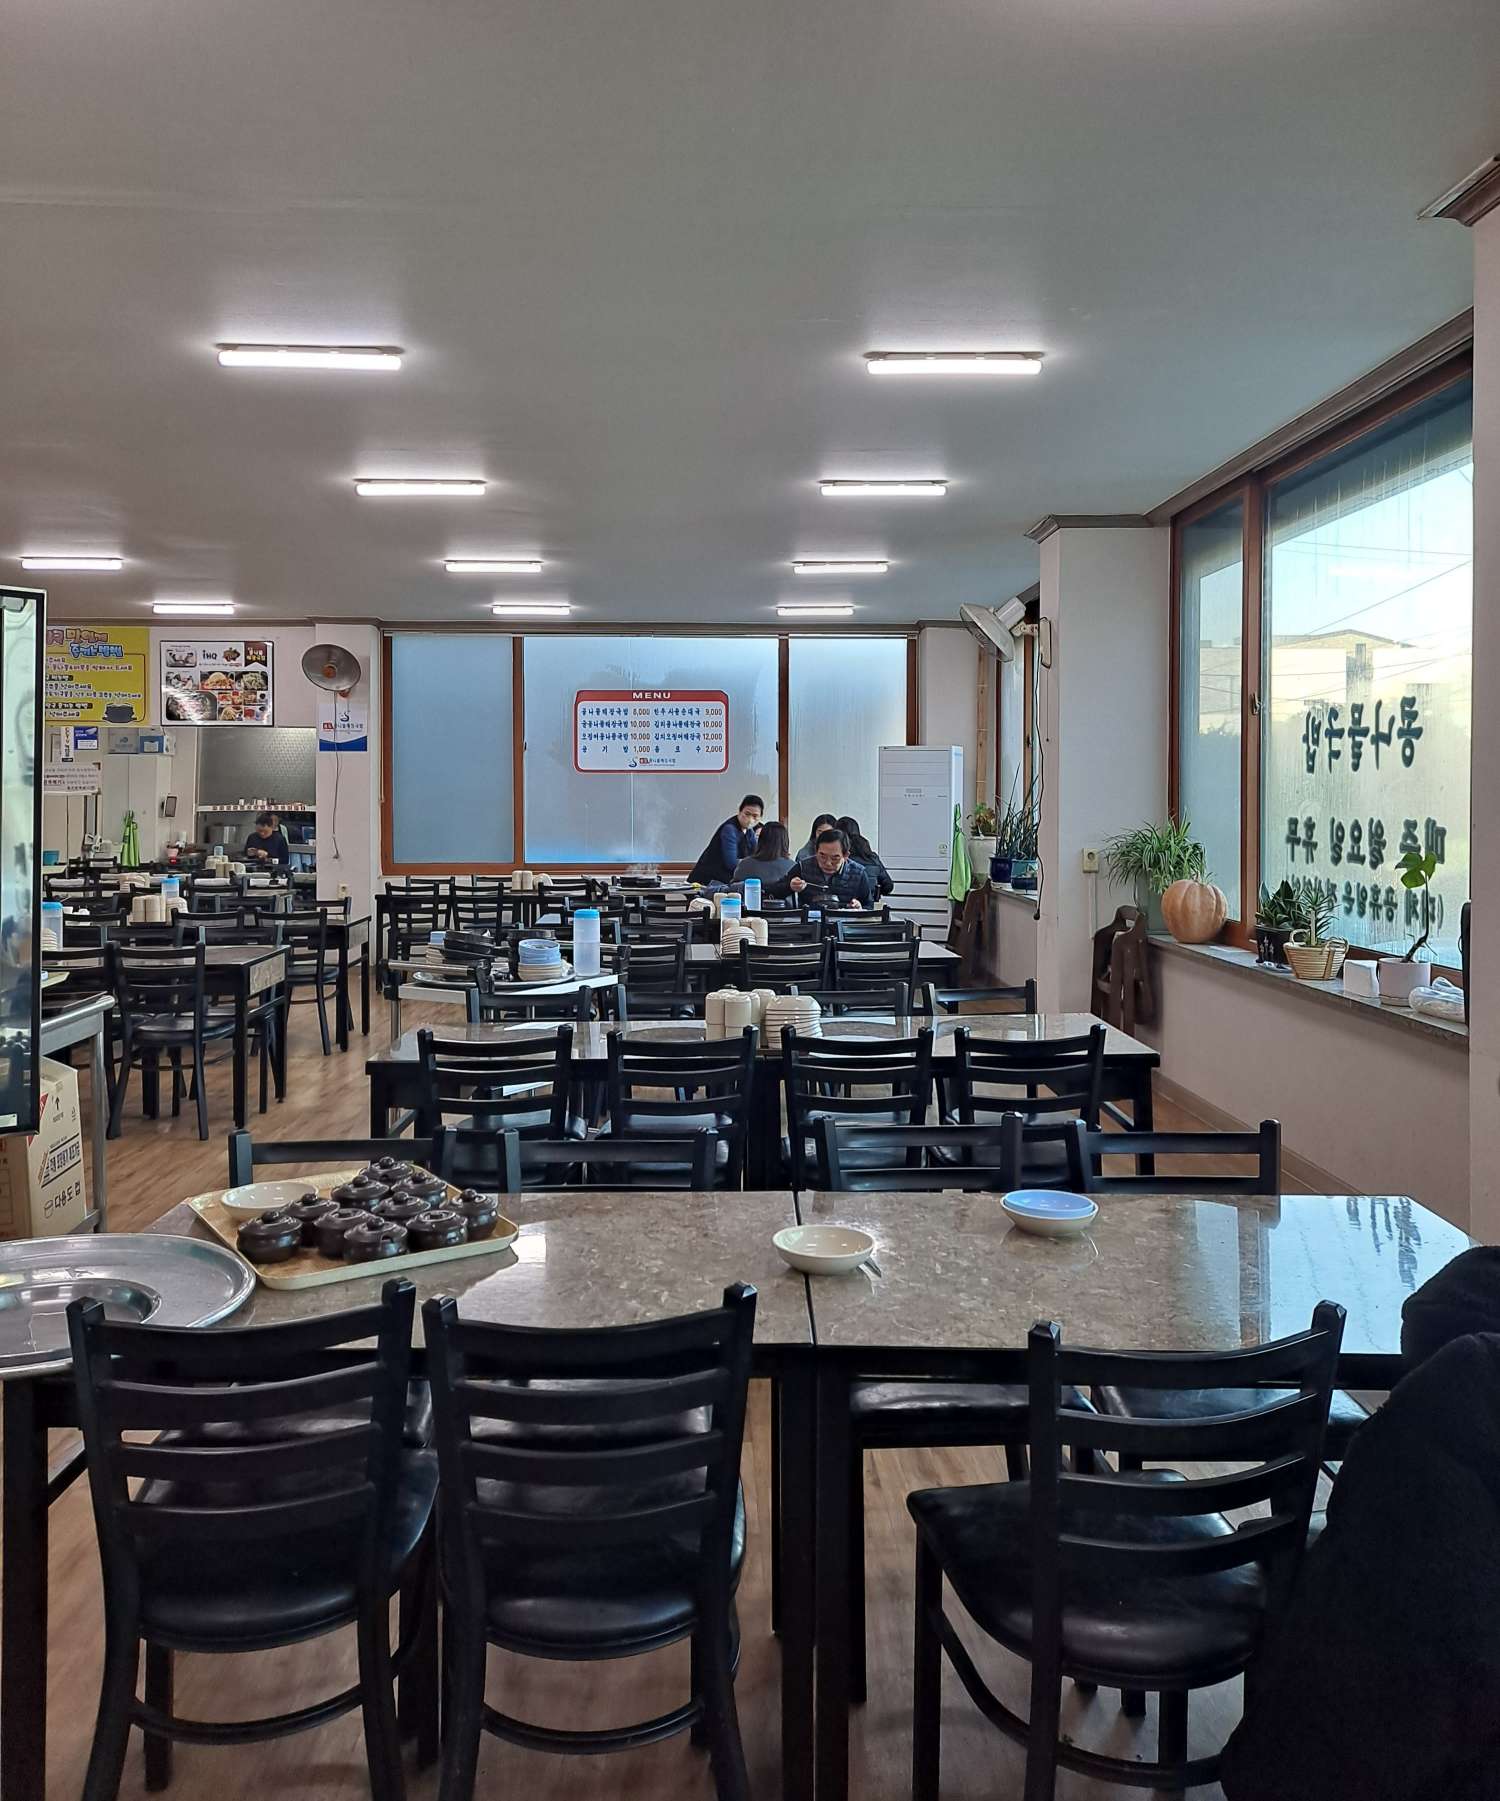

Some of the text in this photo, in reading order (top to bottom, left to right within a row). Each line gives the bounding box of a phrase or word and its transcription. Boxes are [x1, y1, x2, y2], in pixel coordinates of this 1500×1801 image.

[630, 720, 650, 728] 10,000
[703, 720, 723, 728] 10,000
[633, 745, 650, 753] 1,000
[705, 745, 723, 753] 2,000
